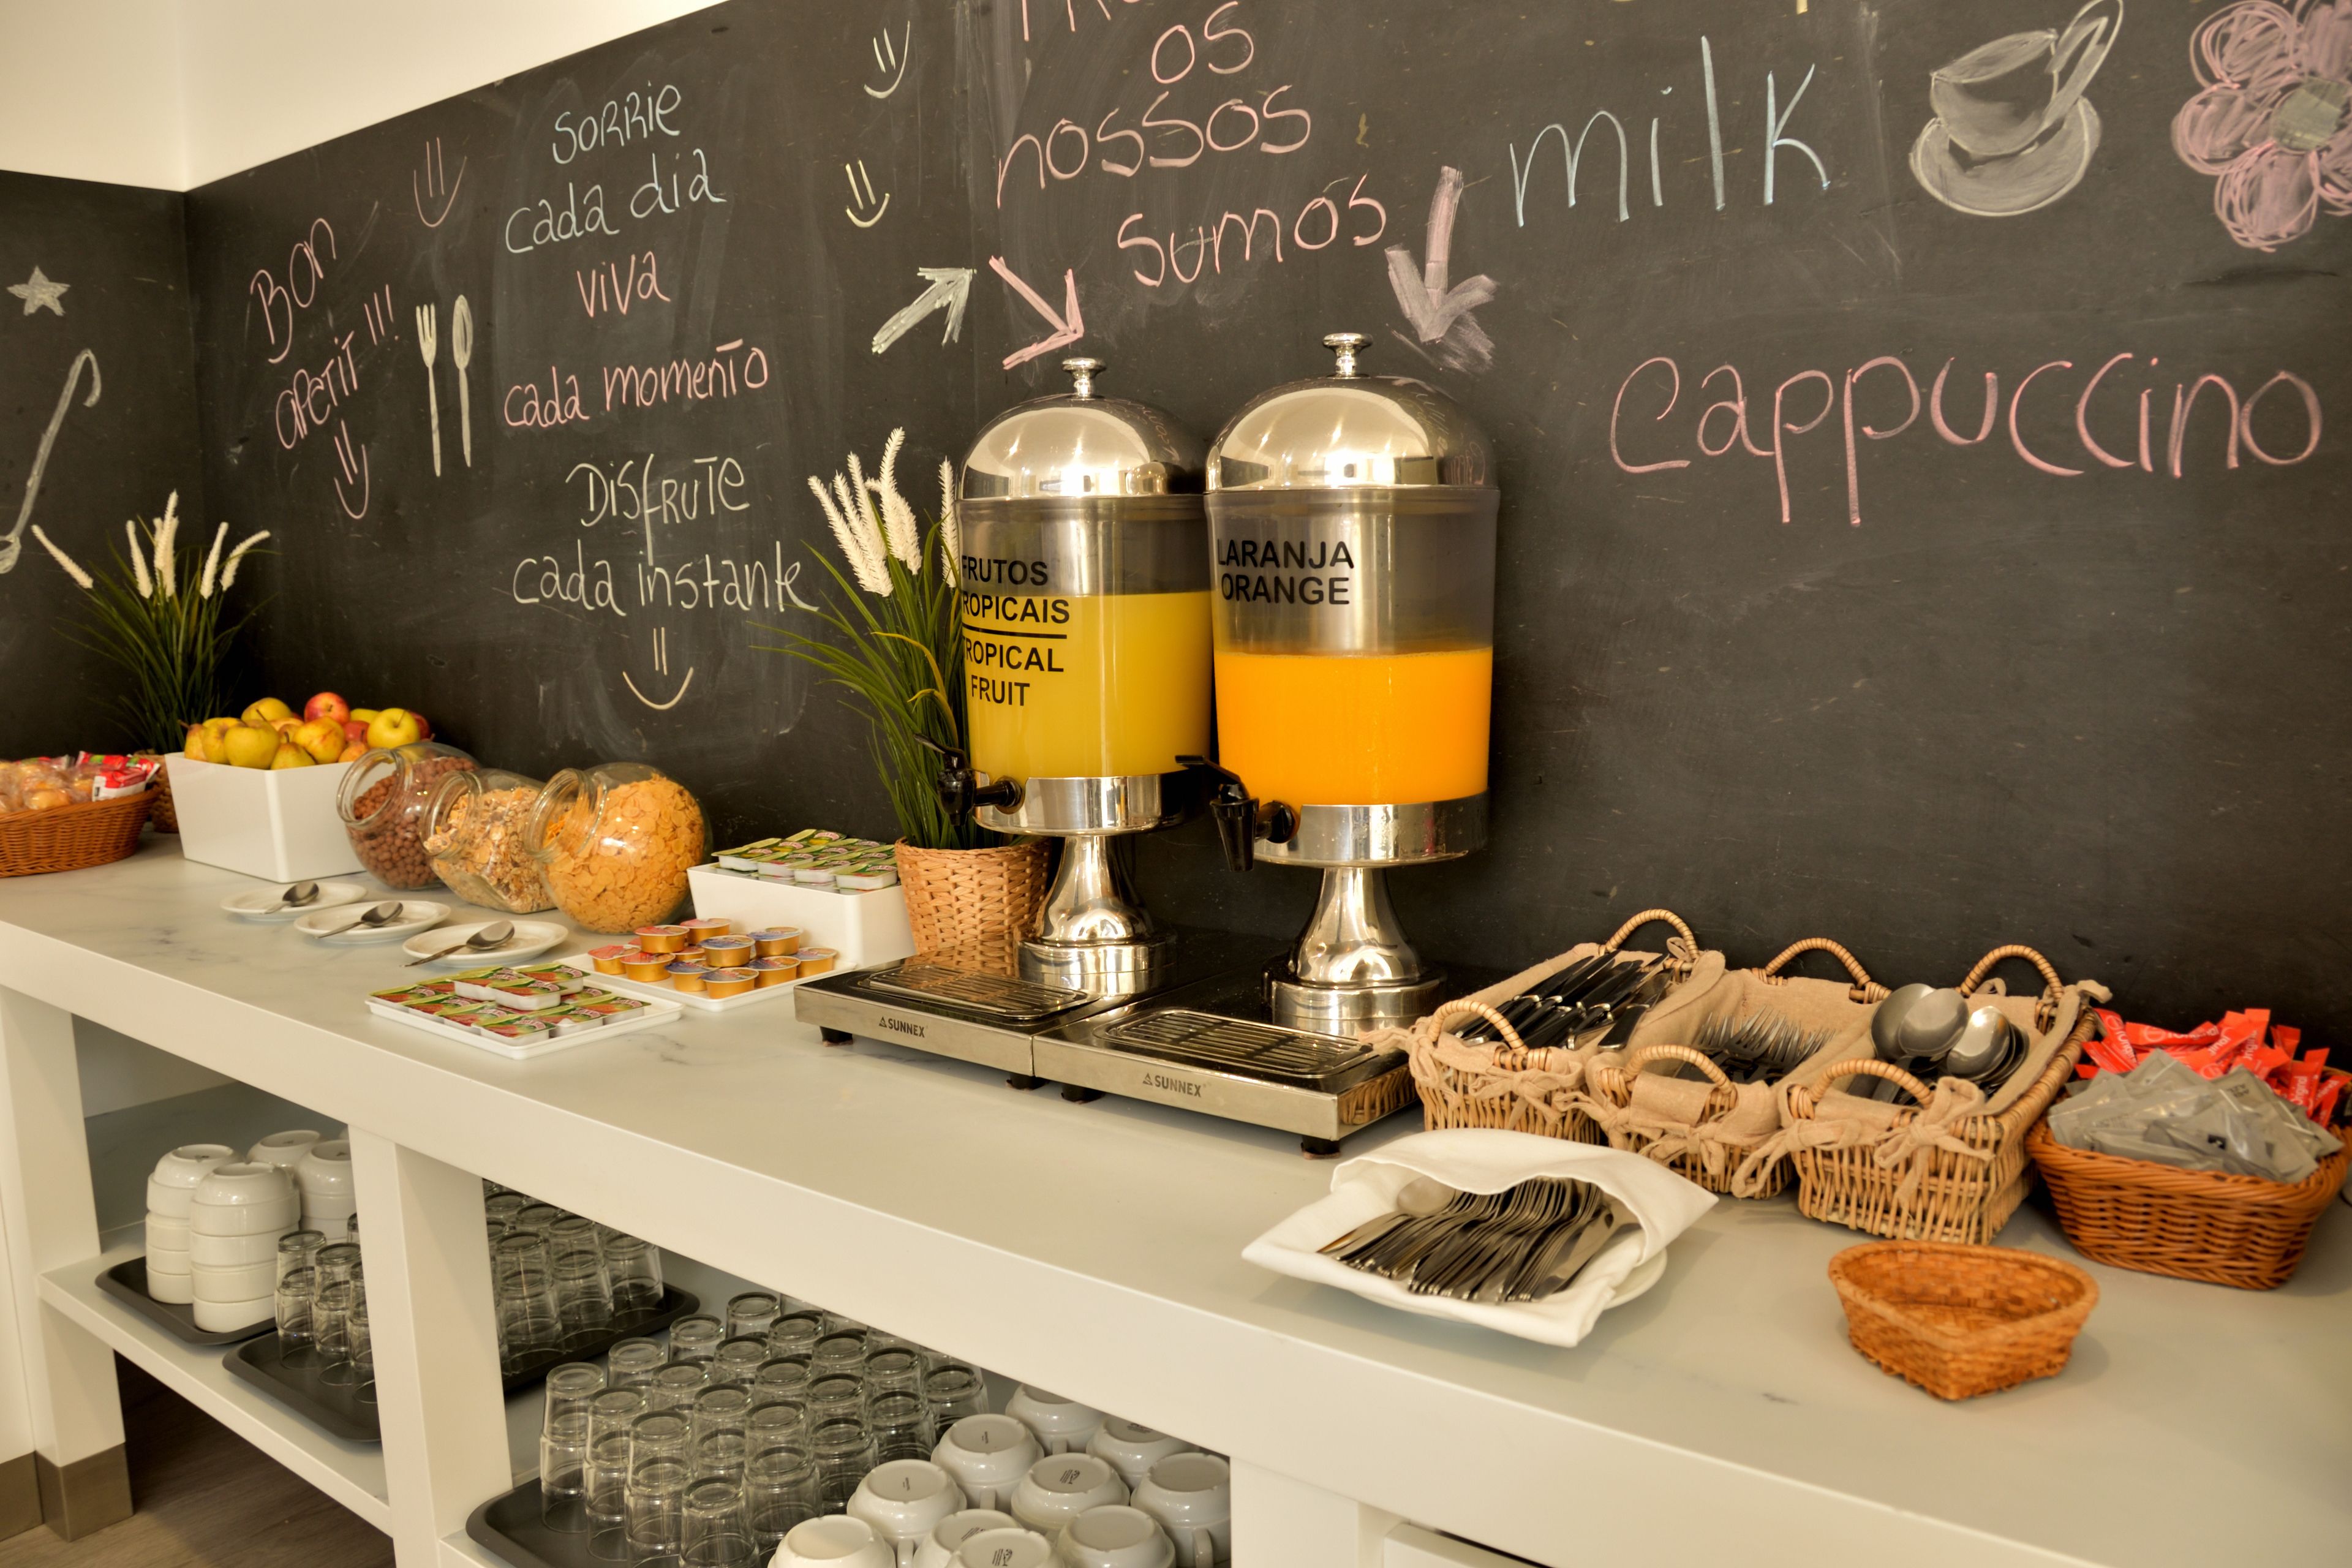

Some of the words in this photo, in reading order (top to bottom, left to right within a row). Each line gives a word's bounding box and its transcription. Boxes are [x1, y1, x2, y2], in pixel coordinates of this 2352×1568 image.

[1509, 35, 1831, 227] milk
[1217, 538, 1354, 569] LARANJA
[962, 555, 1049, 586] FRUTOS
[1221, 573, 1350, 605] ORANGE
[971, 674, 1030, 706] FRUIT
[888, 1018, 925, 1038] SUNNEX
[1155, 1075, 1202, 1098] SUNNEX
